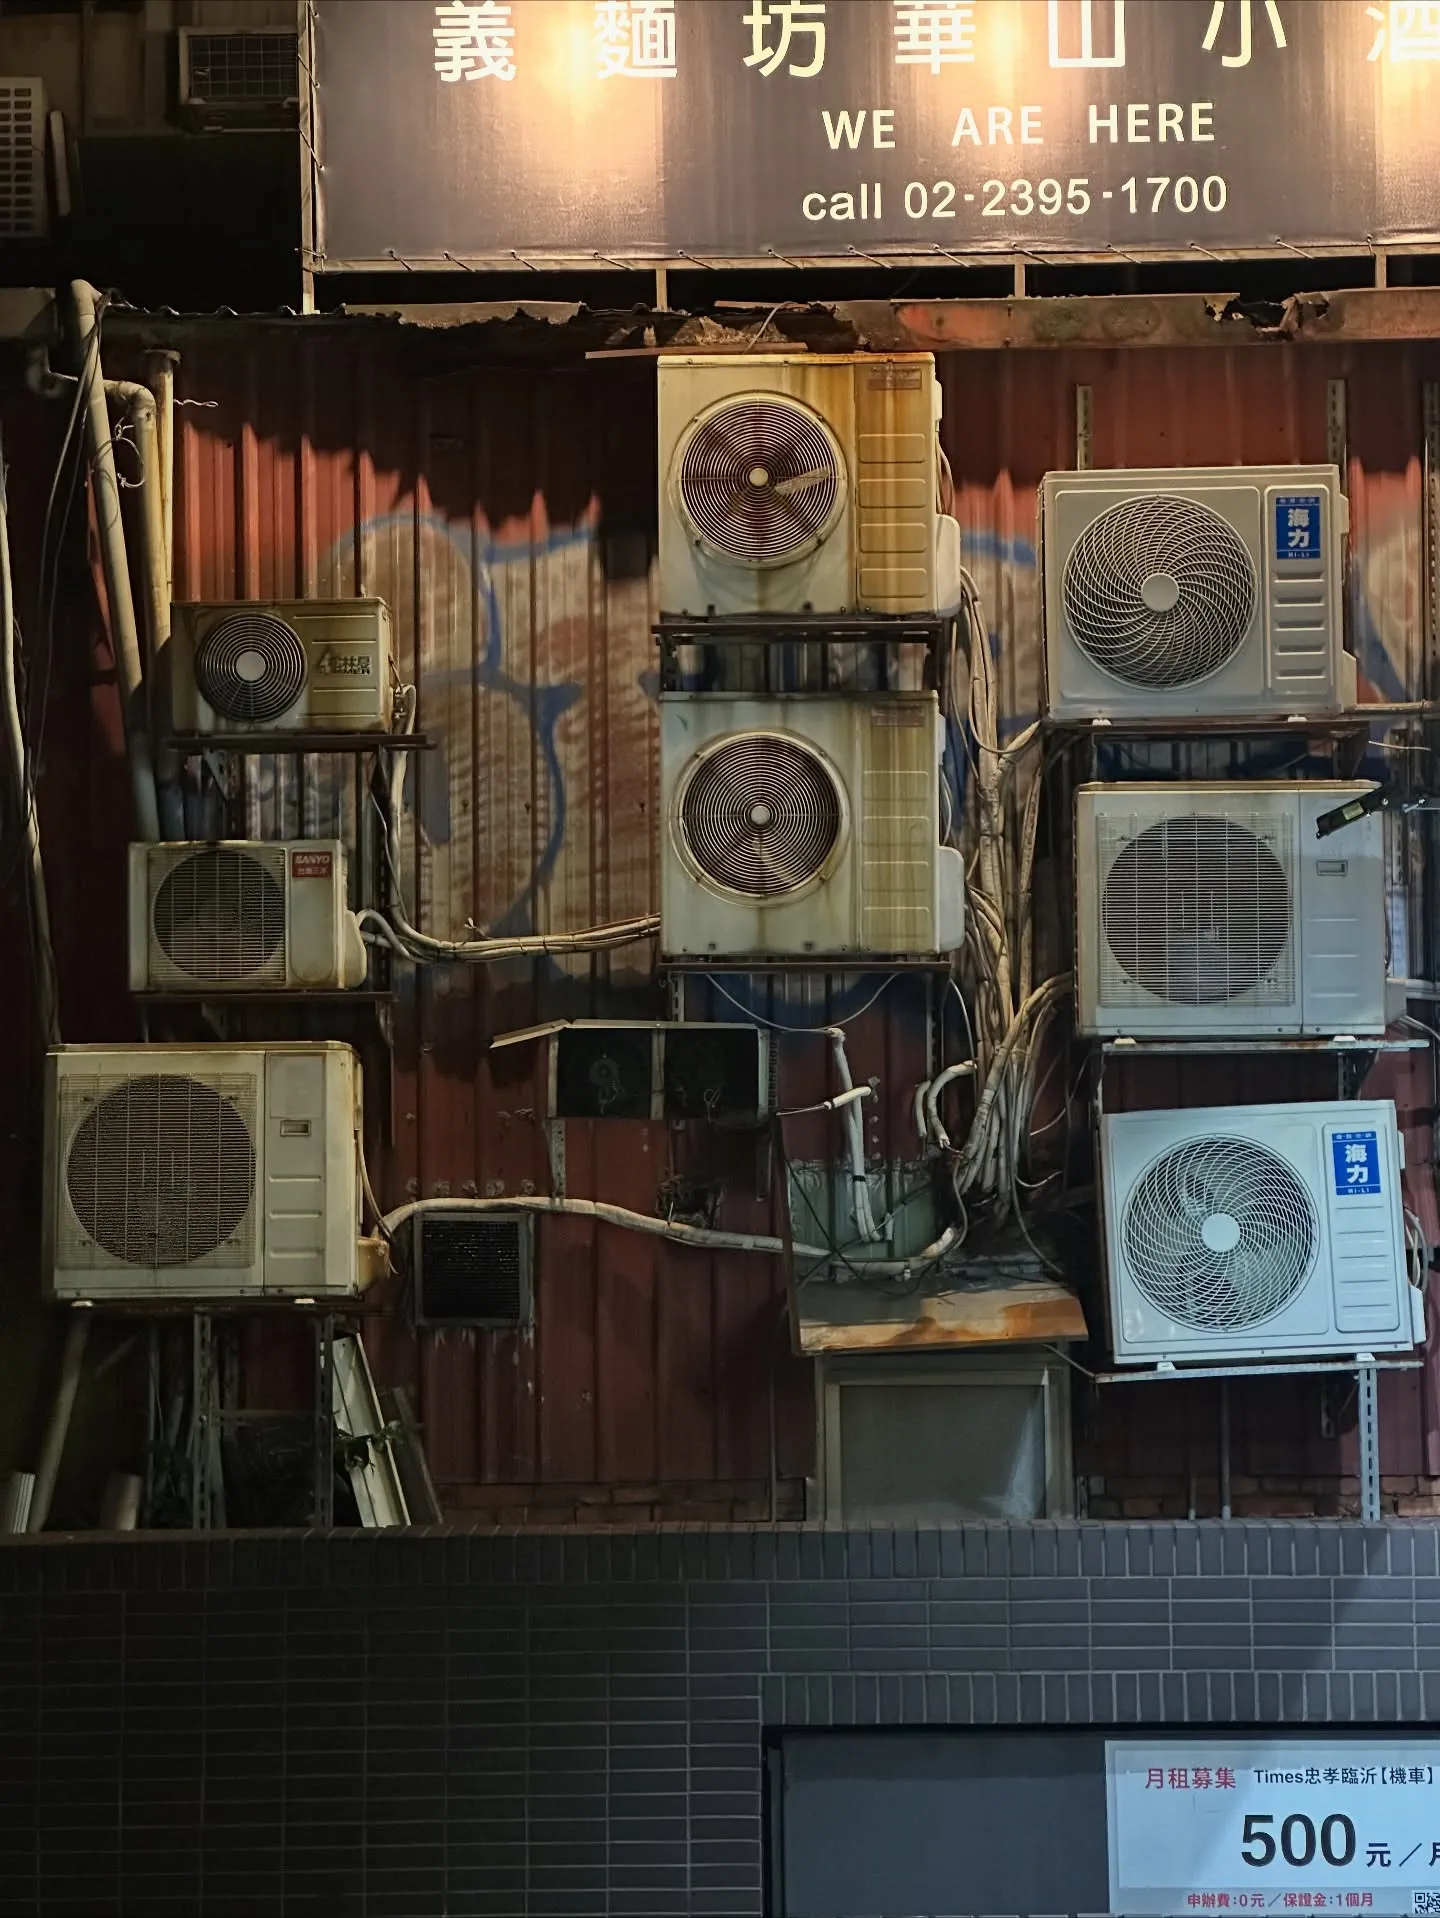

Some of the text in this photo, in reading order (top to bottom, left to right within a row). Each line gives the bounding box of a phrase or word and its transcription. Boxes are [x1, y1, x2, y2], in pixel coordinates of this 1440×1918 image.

[822, 103, 1216, 150] WE ARE HERE
[801, 176, 1228, 220] call 02-2395-1700
[1288, 508, 1310, 547] 海力
[295, 855, 330, 864] SANYO
[1344, 1143, 1369, 1184] 海力
[1144, 1767, 1237, 1790] 月租募集
